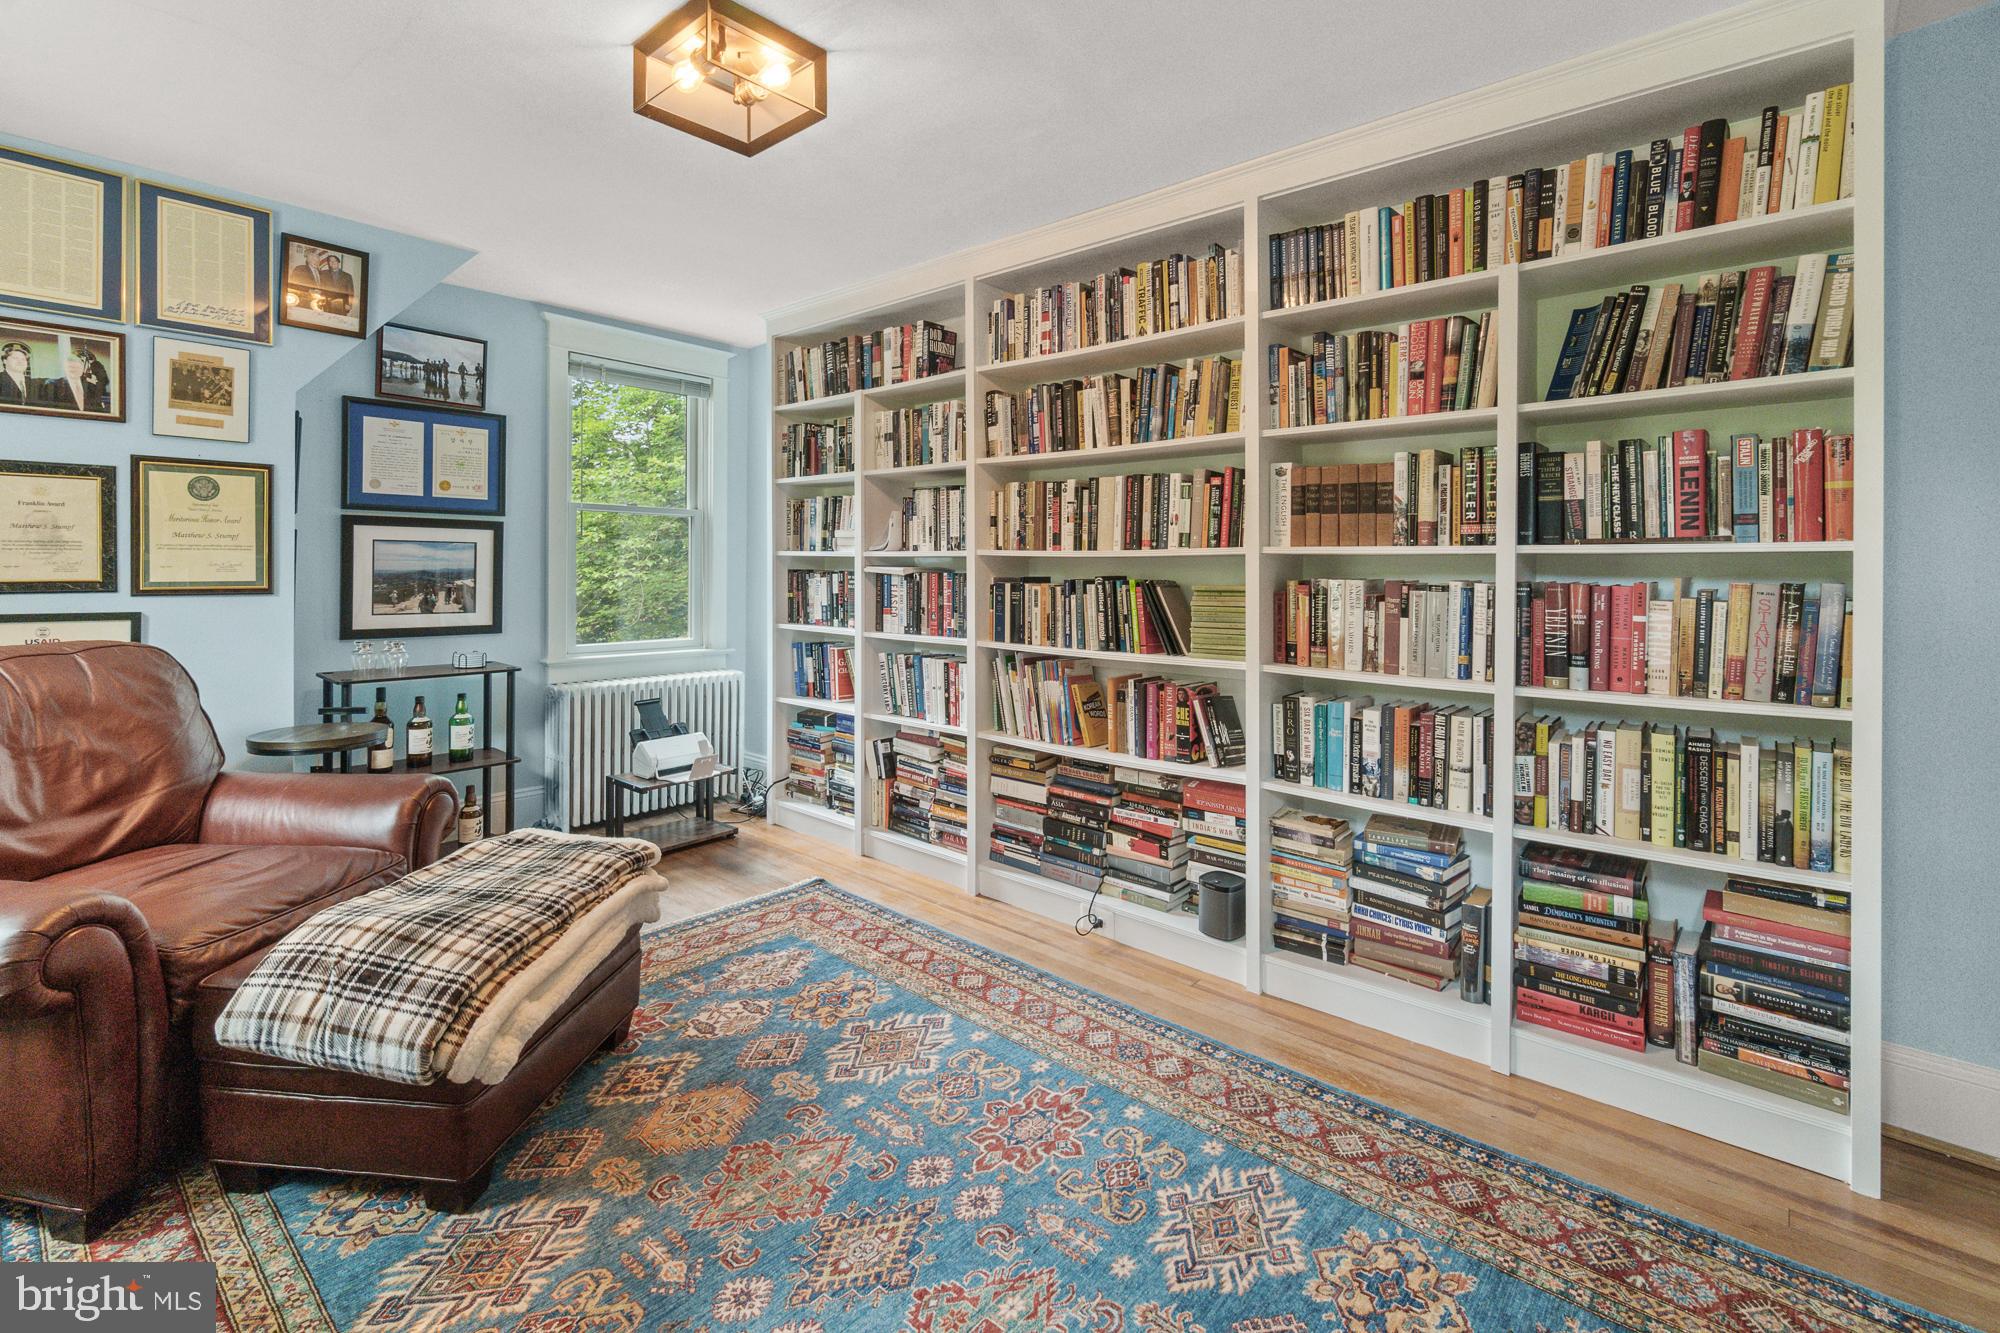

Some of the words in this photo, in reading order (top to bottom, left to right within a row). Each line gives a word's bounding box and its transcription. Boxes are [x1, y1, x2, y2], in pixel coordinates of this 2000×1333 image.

[1687, 135, 1698, 166] DEAD
[1650, 167, 1662, 194] BLUE
[1616, 180, 1624, 206] GLEICK
[1510, 208, 1519, 241] TECHNOLOGY
[1614, 214, 1622, 240] FASTER
[1646, 205, 1658, 237] BLOOD
[1829, 273, 1850, 306] SECOND
[1138, 287, 1146, 324] TRAFFIC
[1629, 304, 1638, 315] The
[1724, 301, 1734, 315] The
[1746, 278, 1766, 335] SLEEPWALKERS
[1621, 315, 1634, 338] Manager
[1719, 318, 1731, 343] Vertigo
[1823, 308, 1844, 337] WORLD
[1410, 323, 1418, 362] RHODES
[1820, 339, 1838, 357] WAR
[1326, 344, 1334, 370] FALLOUT
[1612, 345, 1626, 372] Negotiator
[1690, 343, 1699, 368] MILLARD
[1716, 345, 1728, 365] Years
[1230, 391, 1239, 410] QUEST
[1740, 440, 1751, 465] STALIN
[1565, 467, 1577, 499] STRANGE
[1611, 464, 1619, 482] THE
[1466, 462, 1476, 519] HITLER
[1487, 461, 1496, 519] HITLER
[1612, 483, 1620, 503] NEW
[1680, 466, 1699, 530] LENIN
[1570, 500, 1583, 529] VICTORY
[1613, 505, 1621, 533] CLASS
[1098, 613, 1106, 641] paranoia
[1522, 607, 1530, 627] FALL
[1545, 608, 1567, 657] YELTSIN
[1594, 620, 1603, 647] KREMLIN
[1752, 599, 1771, 684] STANLEY
[1784, 612, 1798, 652] Thousand
[1521, 636, 1530, 656] NEW
[1594, 648, 1603, 669] RISING
[1783, 654, 1794, 674] Hills
[881, 673, 889, 695] VICTORY
[1435, 715, 1445, 726] ALL
[1435, 726, 1445, 739] FALL
[1434, 739, 1445, 759] DOWN
[1603, 739, 1613, 748] NO
[1603, 751, 1612, 767] EASY
[1800, 764, 1808, 774] LIVE
[1586, 769, 1594, 794] VALLEY'S
[1603, 769, 1611, 781] DAY
[1699, 755, 1708, 791] DESCENT
[1800, 787, 1808, 810] PERISH
[1116, 815, 1142, 828] Windfall
[1192, 822, 1217, 834] INDIA'S
[1218, 828, 1233, 836] WAR
[1699, 806, 1708, 833] CHAOS
[1547, 869, 1575, 883] passing
[1578, 874, 1586, 882] of
[1599, 878, 1629, 891] illusion
[1523, 903, 1539, 912] SANDEL
[1369, 907, 1392, 923] CHOICES
[1394, 916, 1413, 929] CYRUS
[1414, 922, 1432, 935] VANCE
[1772, 937, 1807, 950] Twentieth
[1807, 943, 1832, 956] Century
[1653, 968, 1668, 981] THE
[1579, 1005, 1617, 1023] KARGIL
[1653, 982, 1668, 1028] WHISPERERS
[1753, 992, 1807, 1009] THEODORE
[1812, 1005, 1833, 1016] REX
[1702, 1031, 1730, 1044] STEPHEN
[1727, 1023, 1739, 1031] The
[1743, 1027, 1771, 1038] Elegant
[1774, 1034, 1807, 1047] Universe
[1787, 1054, 1810, 1066] GRAND
[1811, 1061, 1836, 1073] DESIGN
